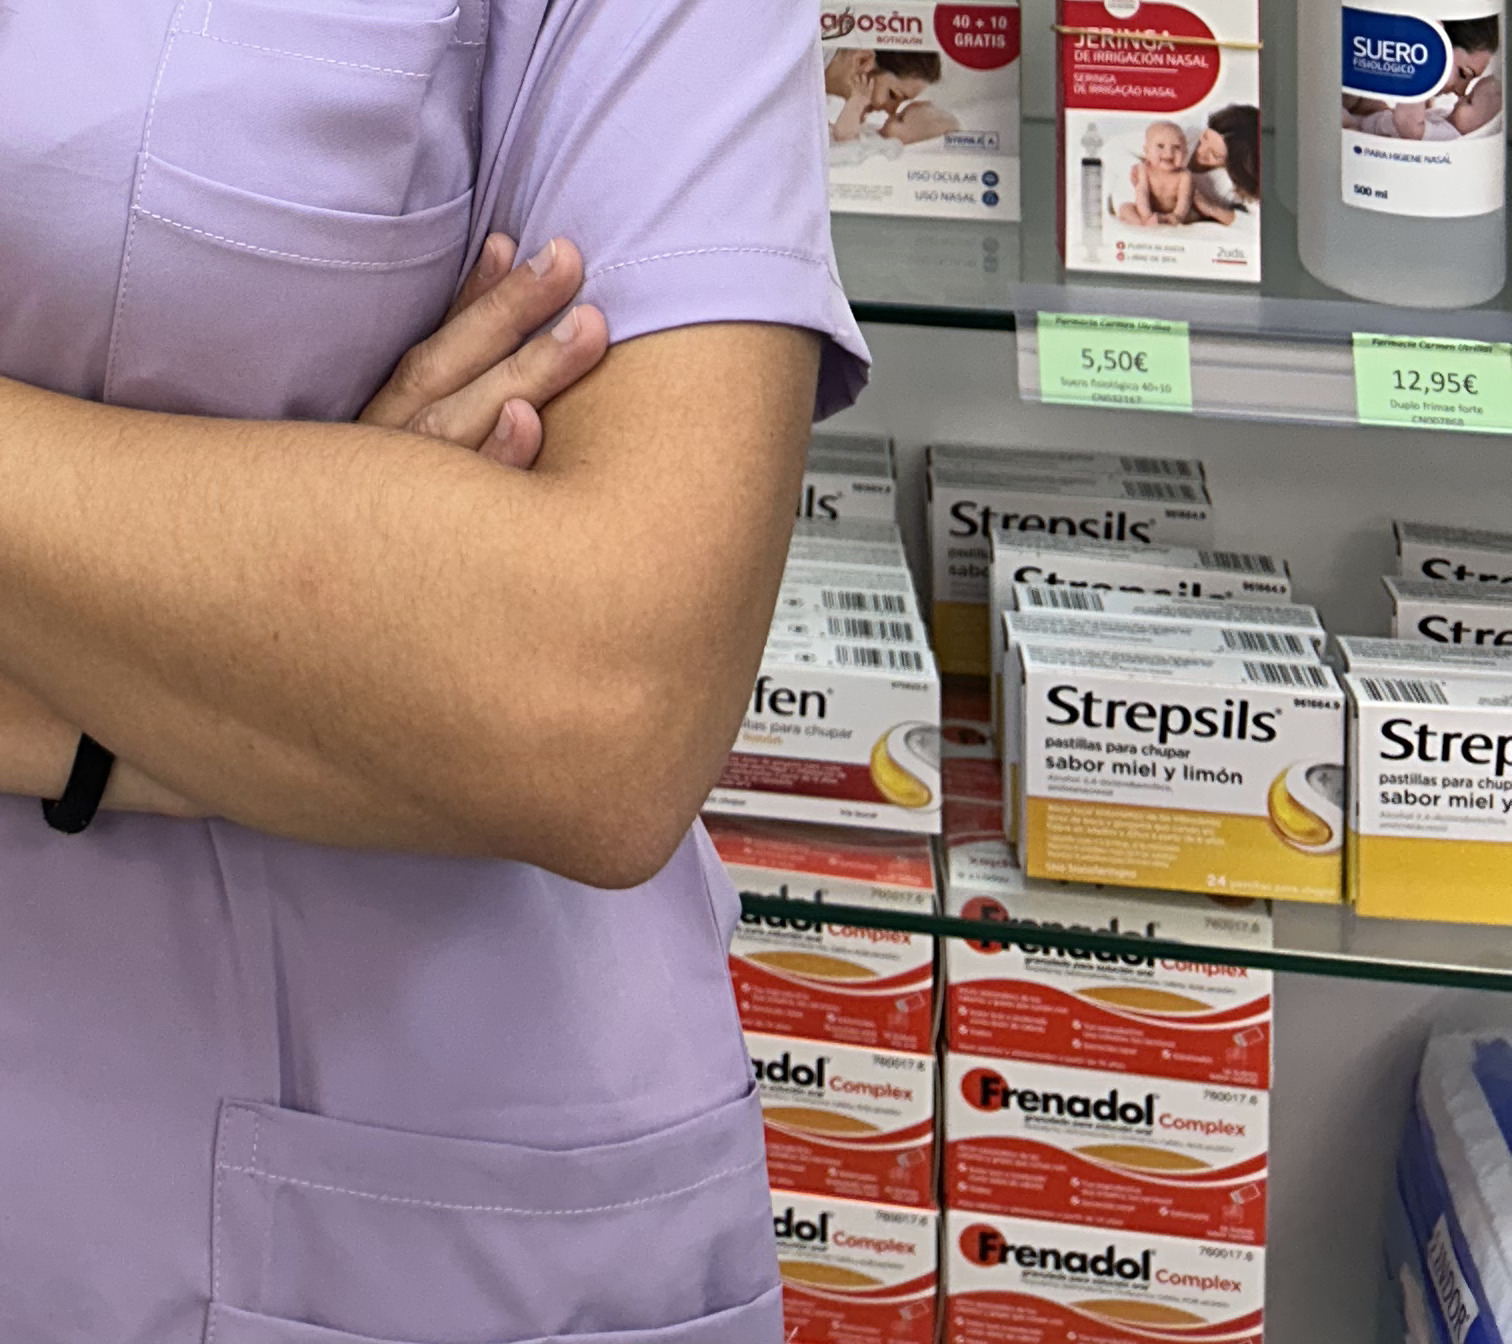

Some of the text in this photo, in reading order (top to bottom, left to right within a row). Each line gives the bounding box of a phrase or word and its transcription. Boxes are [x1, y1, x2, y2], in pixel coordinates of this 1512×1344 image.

[955, 33, 1006, 48] GRATIS
[1352, 36, 1429, 66] SUERO
[1081, 347, 1148, 373] 5,50€
[1391, 368, 1478, 396] 12,95€
[1045, 684, 1278, 743] Strepsils
[1044, 736, 1190, 760] pastillas para chupar
[1045, 753, 1243, 785] sabor miel y limón
[979, 1075, 1246, 1137] Frenadol Complex
